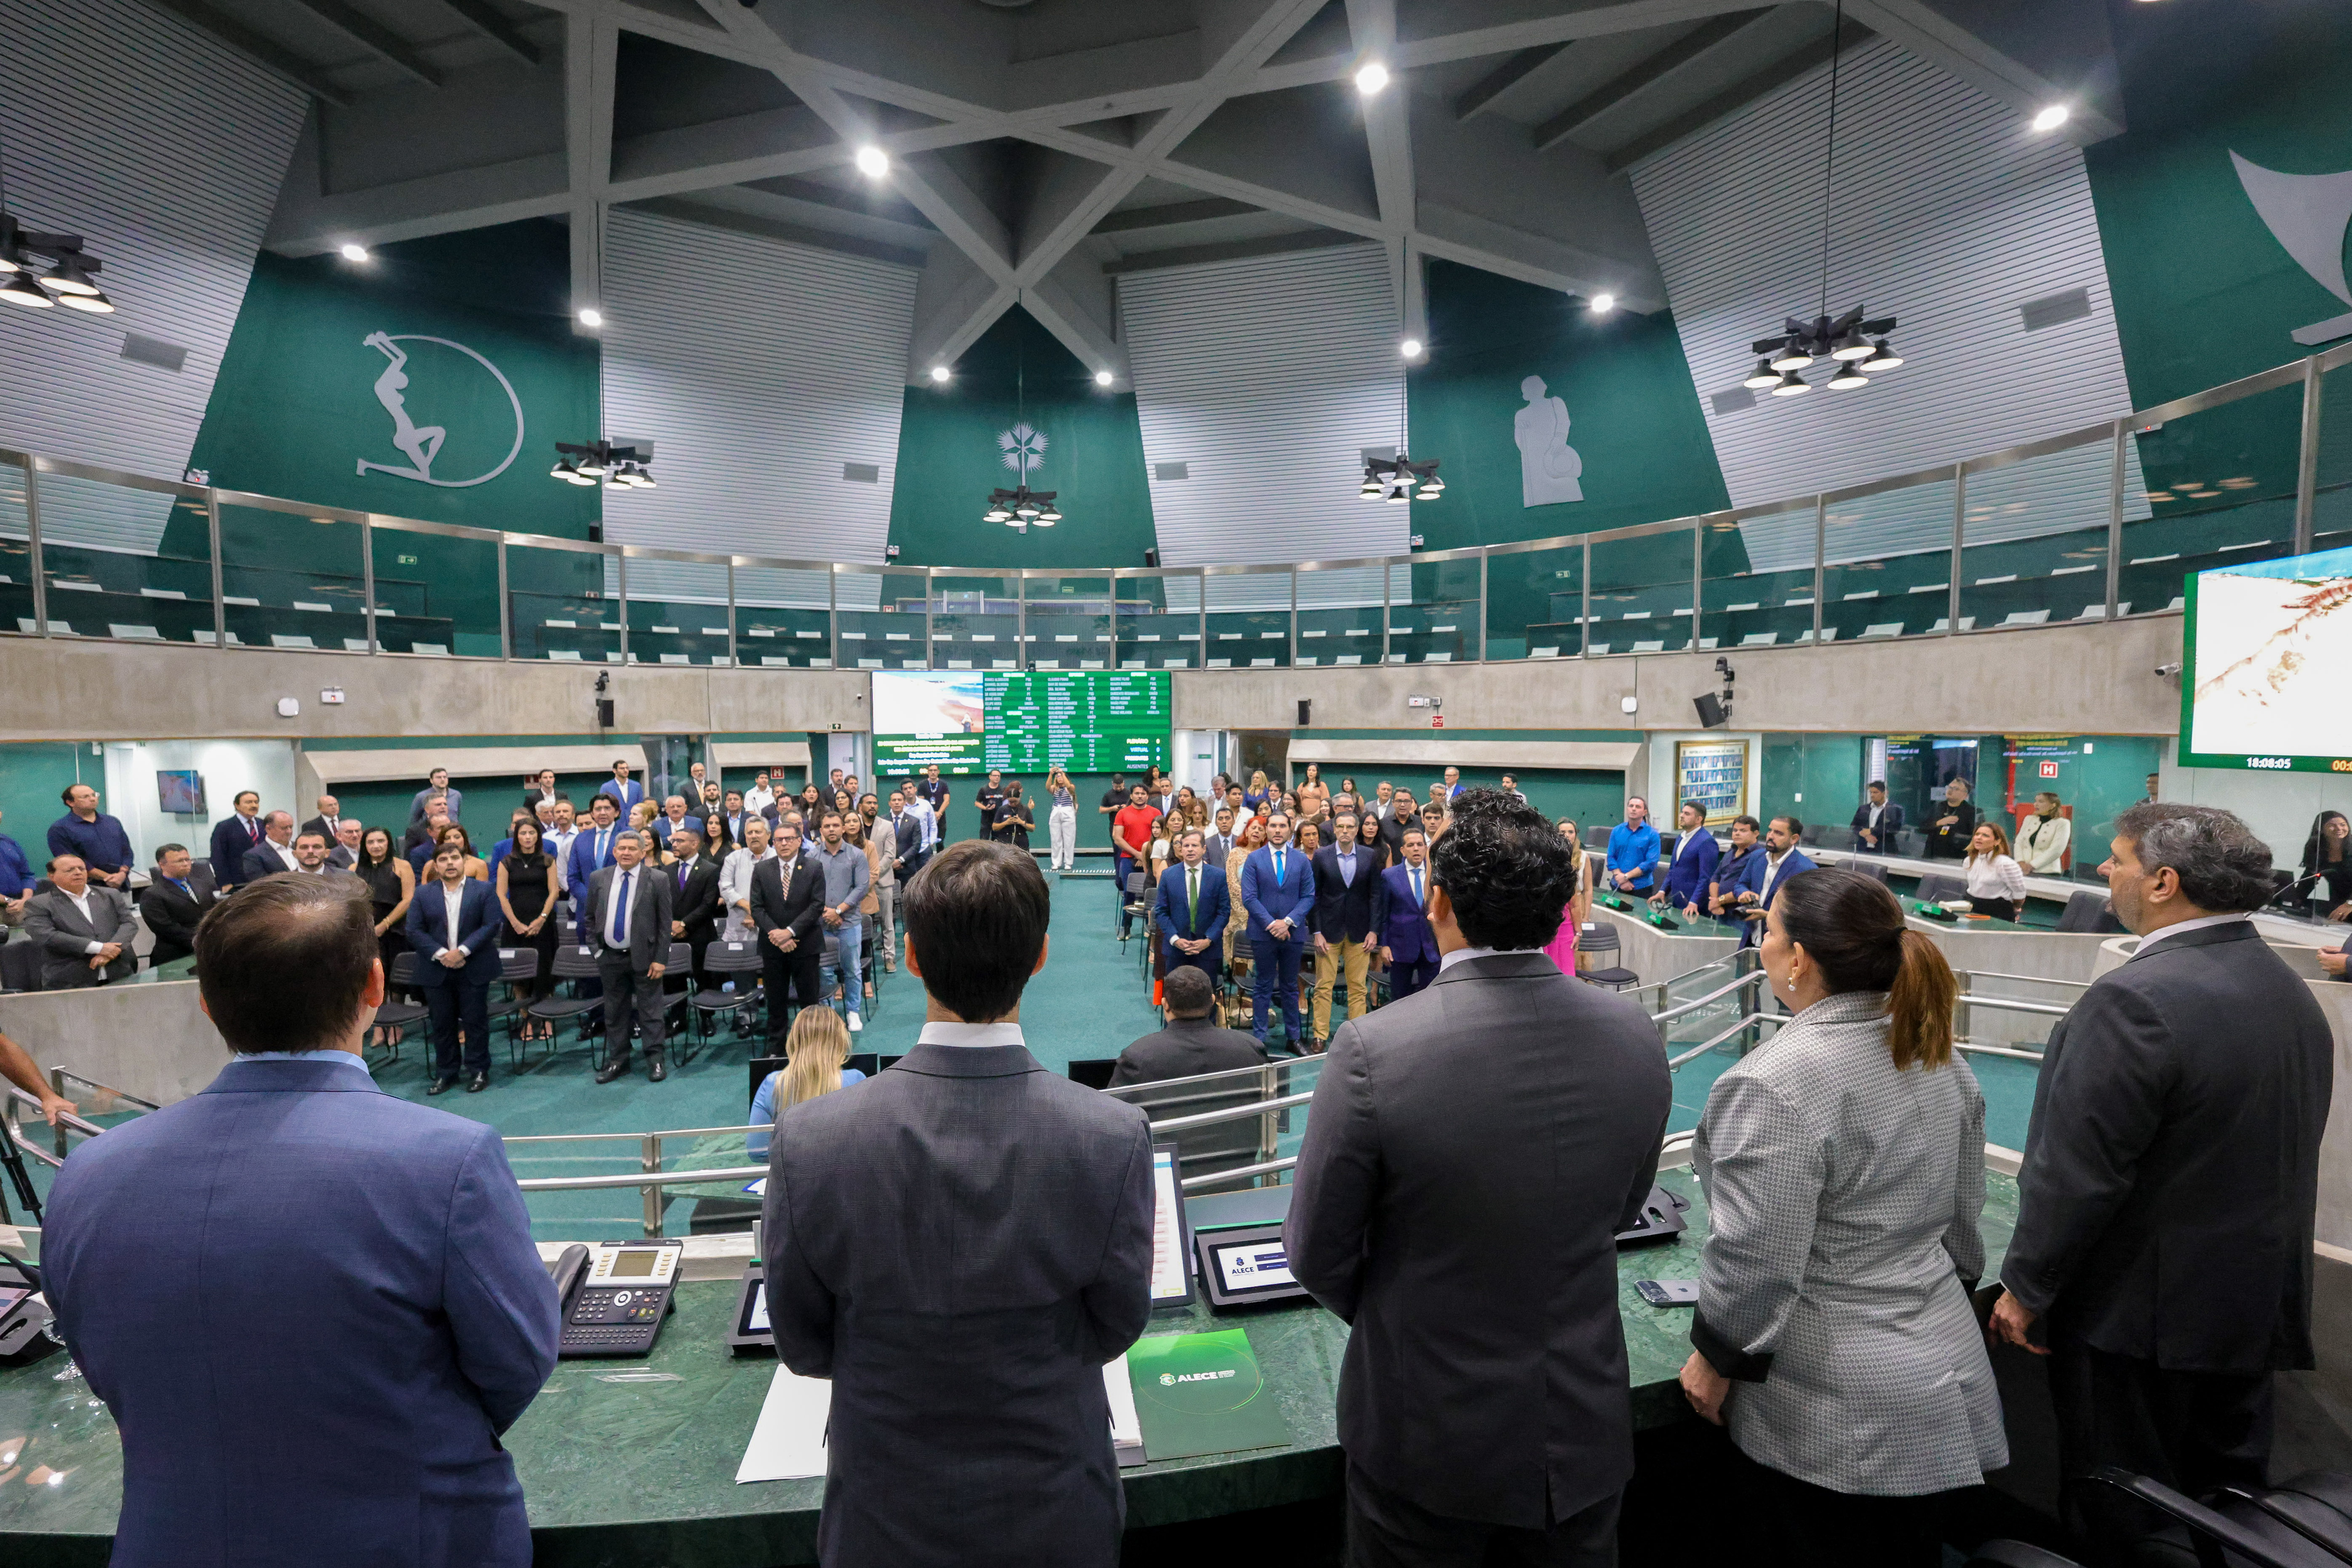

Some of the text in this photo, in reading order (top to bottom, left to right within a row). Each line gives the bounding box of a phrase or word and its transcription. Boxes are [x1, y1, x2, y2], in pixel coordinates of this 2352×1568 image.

[2247, 757, 2291, 769] 18:08:05
[2043, 764, 2053, 775] H
[1178, 1372, 1218, 1382] ALECE
